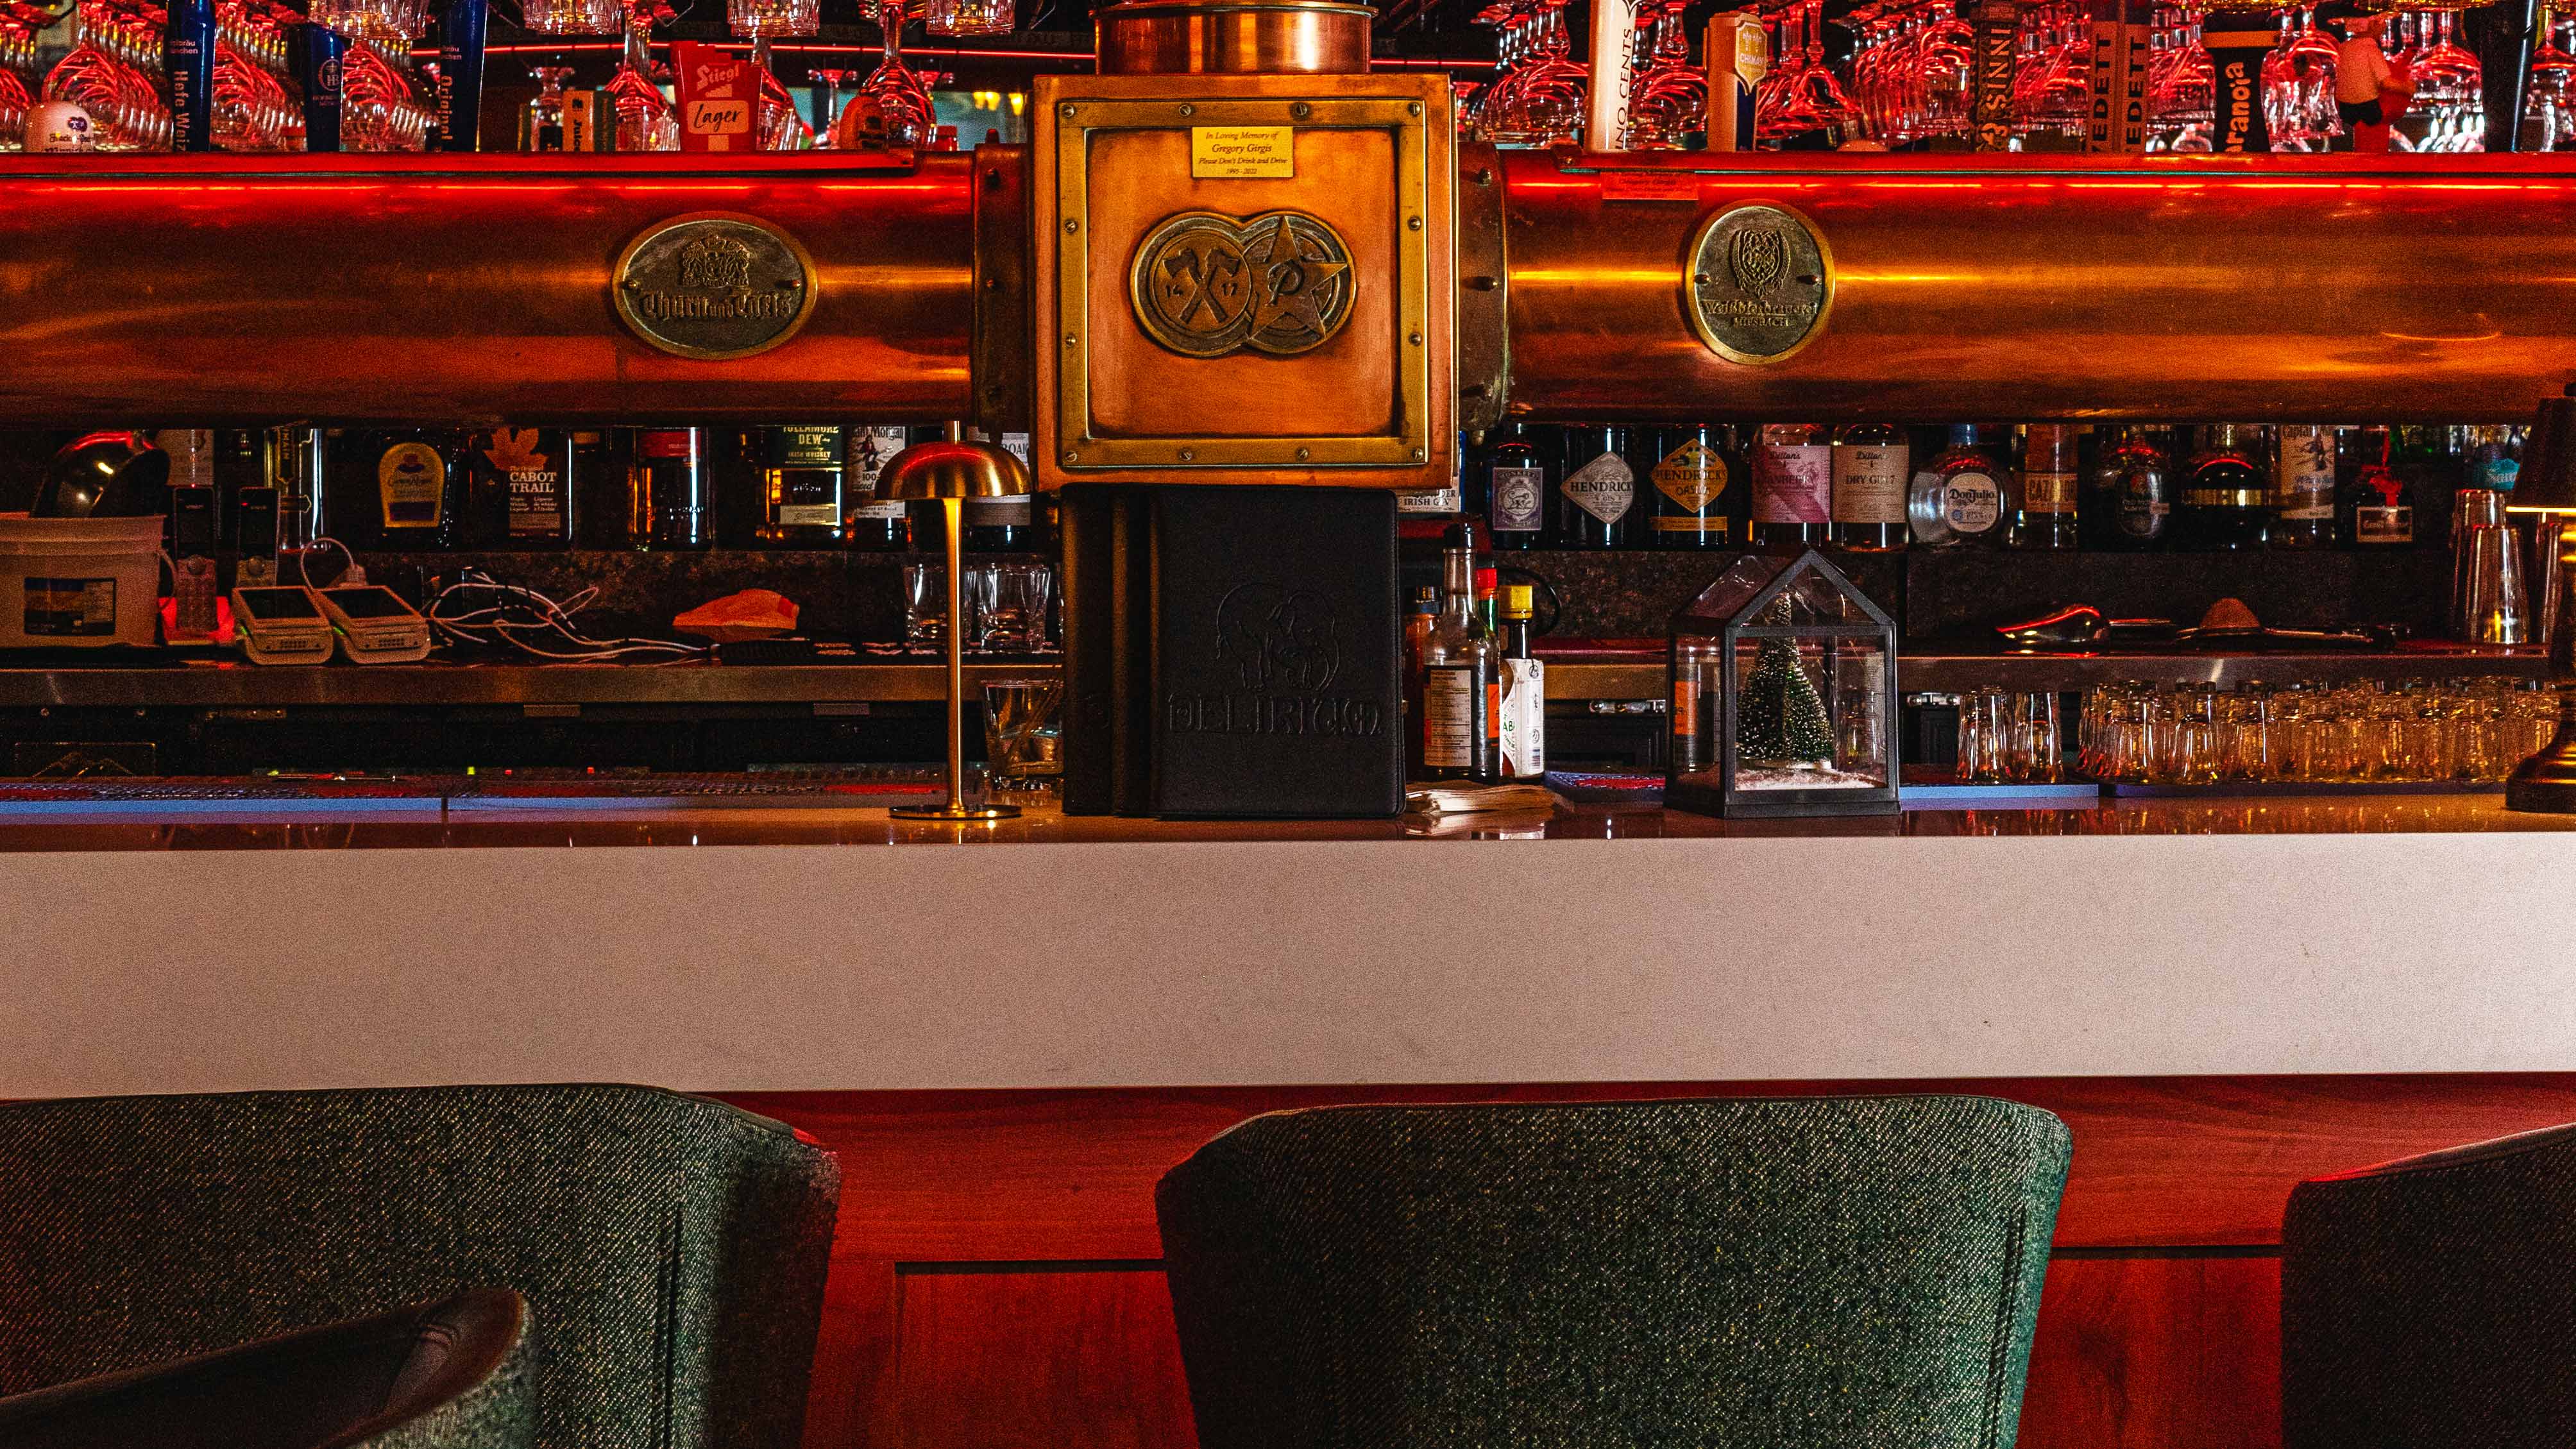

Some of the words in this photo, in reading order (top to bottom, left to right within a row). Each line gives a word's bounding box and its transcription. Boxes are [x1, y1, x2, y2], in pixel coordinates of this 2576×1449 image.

[1619, 28, 1633, 99] CENTS
[697, 65, 739, 90] Stiegl
[174, 71, 189, 107] Hefe
[2125, 37, 2146, 152] EDETT
[441, 76, 453, 140] Original
[693, 103, 747, 132] Lager
[1216, 132, 1239, 140] Loving
[1271, 131, 1280, 140] of
[1212, 144, 1244, 154] Gregory
[1247, 144, 1273, 154] Girgis
[1165, 285, 1183, 298] 14
[1221, 283, 1239, 297] 17
[799, 434, 824, 445] DEW
[872, 427, 904, 440] Morgan
[509, 471, 557, 482] CABOT
[862, 473, 877, 481] 100
[1847, 475, 1866, 484] DRY
[509, 482, 555, 493] TRAIL
